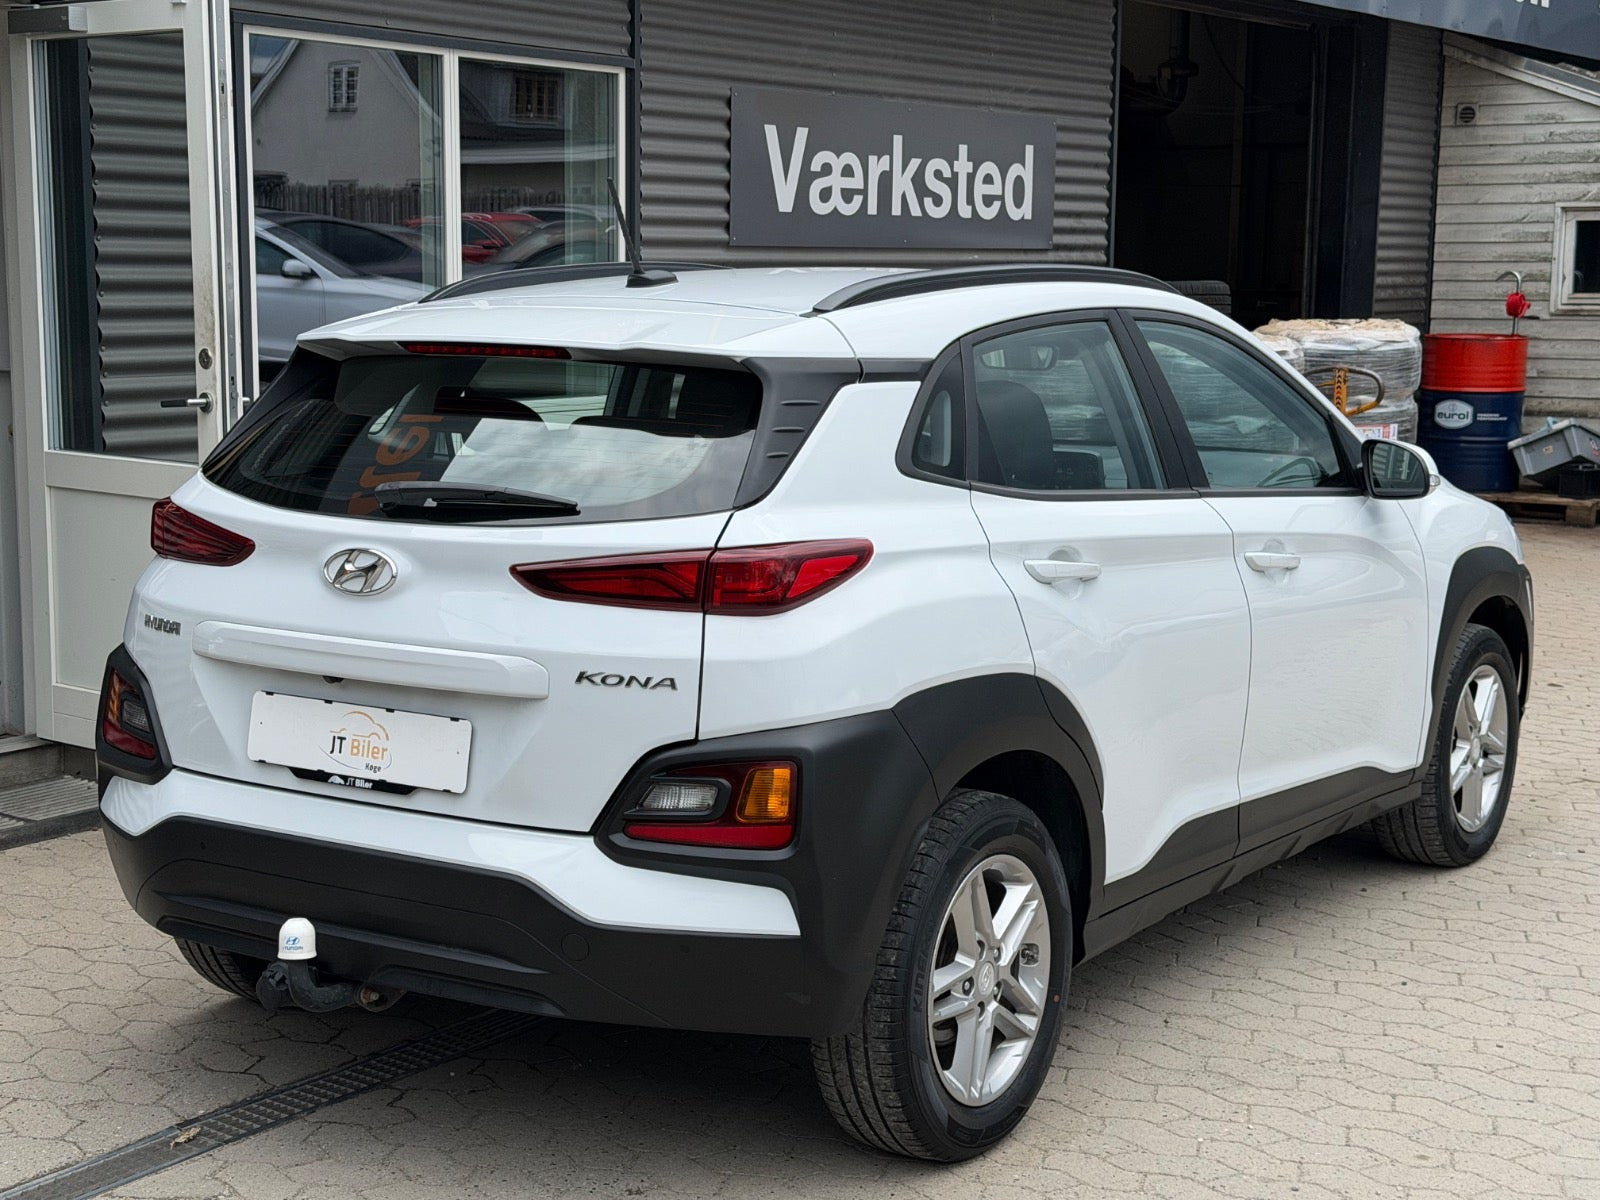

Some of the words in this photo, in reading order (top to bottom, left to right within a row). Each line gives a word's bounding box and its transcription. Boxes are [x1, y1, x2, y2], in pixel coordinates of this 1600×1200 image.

[764, 124, 1034, 221] Værksted
[1437, 411, 1469, 420] eurol
[575, 671, 678, 691] KONA
[329, 735, 347, 754] JT
[350, 738, 388, 760] Biler
[346, 778, 355, 786] JT
[355, 779, 373, 789] Biler
